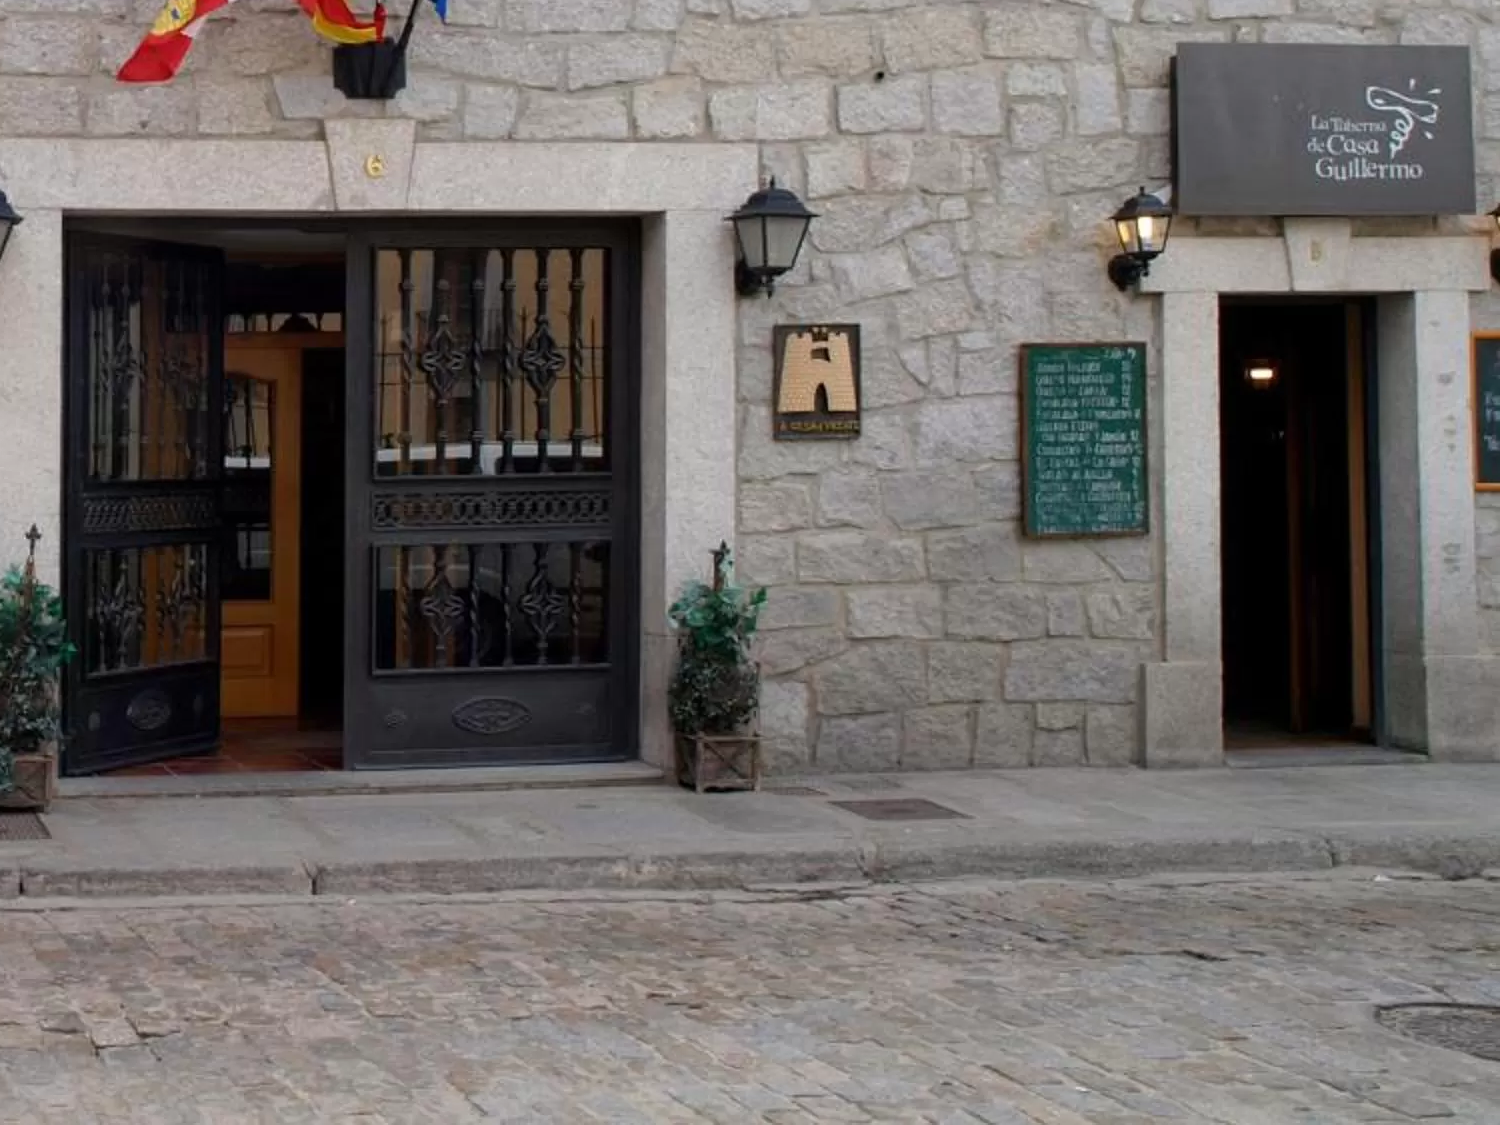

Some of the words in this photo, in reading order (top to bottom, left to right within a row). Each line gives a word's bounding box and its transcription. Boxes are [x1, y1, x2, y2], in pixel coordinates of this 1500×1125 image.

[1311, 115, 1329, 130] La
[1307, 137, 1325, 152] de
[1326, 134, 1380, 155] Casa
[364, 154, 384, 179] 6
[1315, 157, 1424, 181] Guillermo
